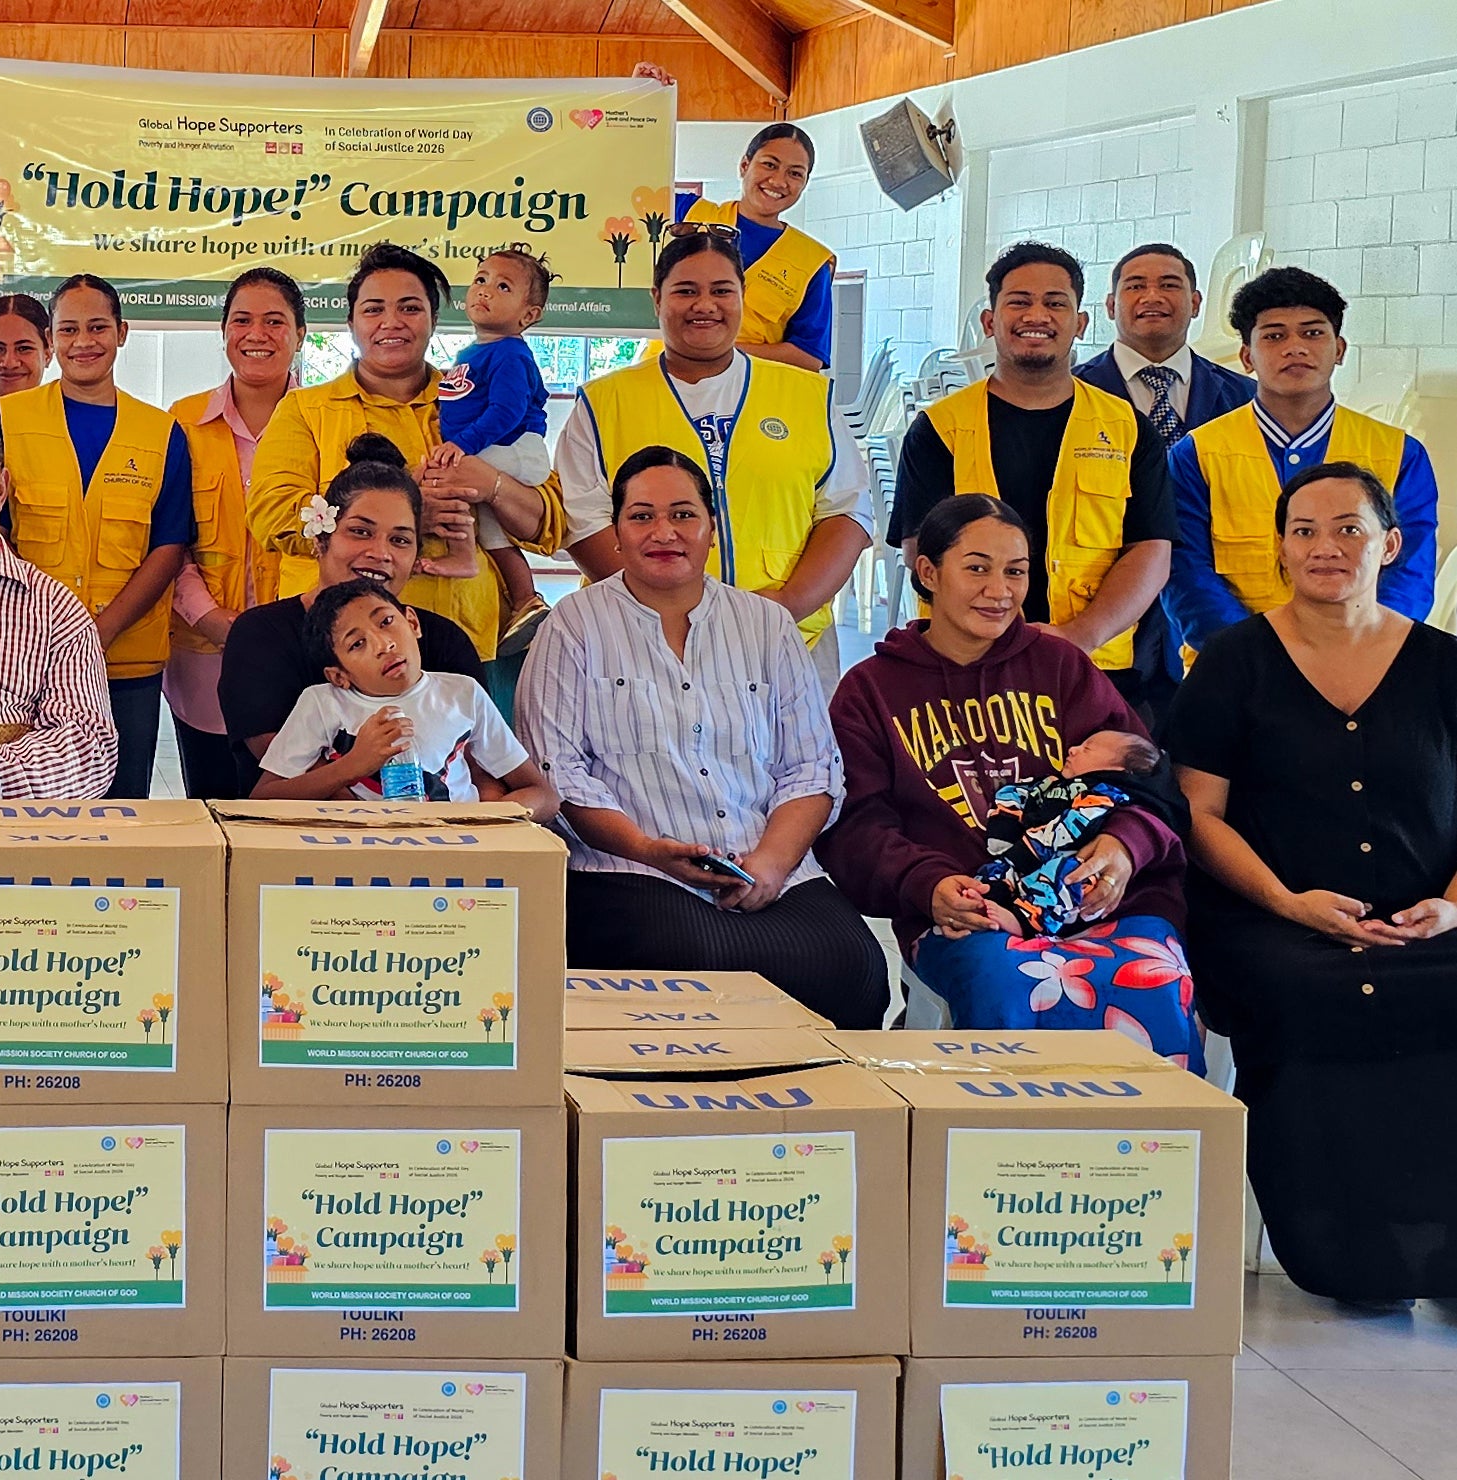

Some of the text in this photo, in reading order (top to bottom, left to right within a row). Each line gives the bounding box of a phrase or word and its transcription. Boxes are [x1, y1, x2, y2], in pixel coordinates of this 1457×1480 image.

[139, 116, 303, 137] Global Hope Supporters
[325, 127, 473, 142] In Celebration of World Day
[139, 140, 234, 151] Poverty and Hunger Alleviation
[325, 141, 444, 153] of Social Justice 2026
[23, 162, 589, 233] “Hold Hope!” Campaign
[94, 233, 124, 252] We
[130, 233, 196, 253] share
[202, 236, 257, 259] hope
[263, 235, 315, 256] with
[320, 244, 334, 256] a
[117, 292, 162, 306] WORLD
[165, 293, 217, 307] MISSION
[543, 302, 611, 312] nternal Affairs
[316, 807, 414, 815] PAK
[8, 834, 109, 842] PAK
[300, 834, 479, 846] UMU
[47, 949, 140, 980] Hope!”
[297, 946, 480, 980] “Hold Hope!”
[313, 982, 461, 1014] Campaign
[624, 1012, 720, 1022] PAK
[629, 1042, 733, 1055] PAK
[932, 1041, 1040, 1055] PAK
[4, 1076, 81, 1089] PH: 26208
[345, 1075, 421, 1088] PH: 26208
[956, 1081, 1142, 1098] UMU
[631, 1087, 814, 1111] UMU
[55, 1187, 148, 1219] Hope!”
[302, 1190, 482, 1222] “Hold Hope!”
[641, 1194, 819, 1228] “Hold Hope!”
[984, 1189, 1161, 1221] “Hold Hope!”
[317, 1224, 463, 1255] Campaign
[656, 1230, 802, 1261] Campaign
[998, 1223, 1142, 1254] Campaign
[2, 1329, 78, 1342] PH: 26208
[340, 1327, 416, 1341] PH: 26208
[692, 1328, 767, 1341] PH: 26208
[1023, 1327, 1098, 1339] PH: 26208
[306, 1429, 486, 1464] “Hold Hope!”
[978, 1440, 1149, 1470] “Hold Hope!”
[50, 1445, 142, 1477] Hope!”
